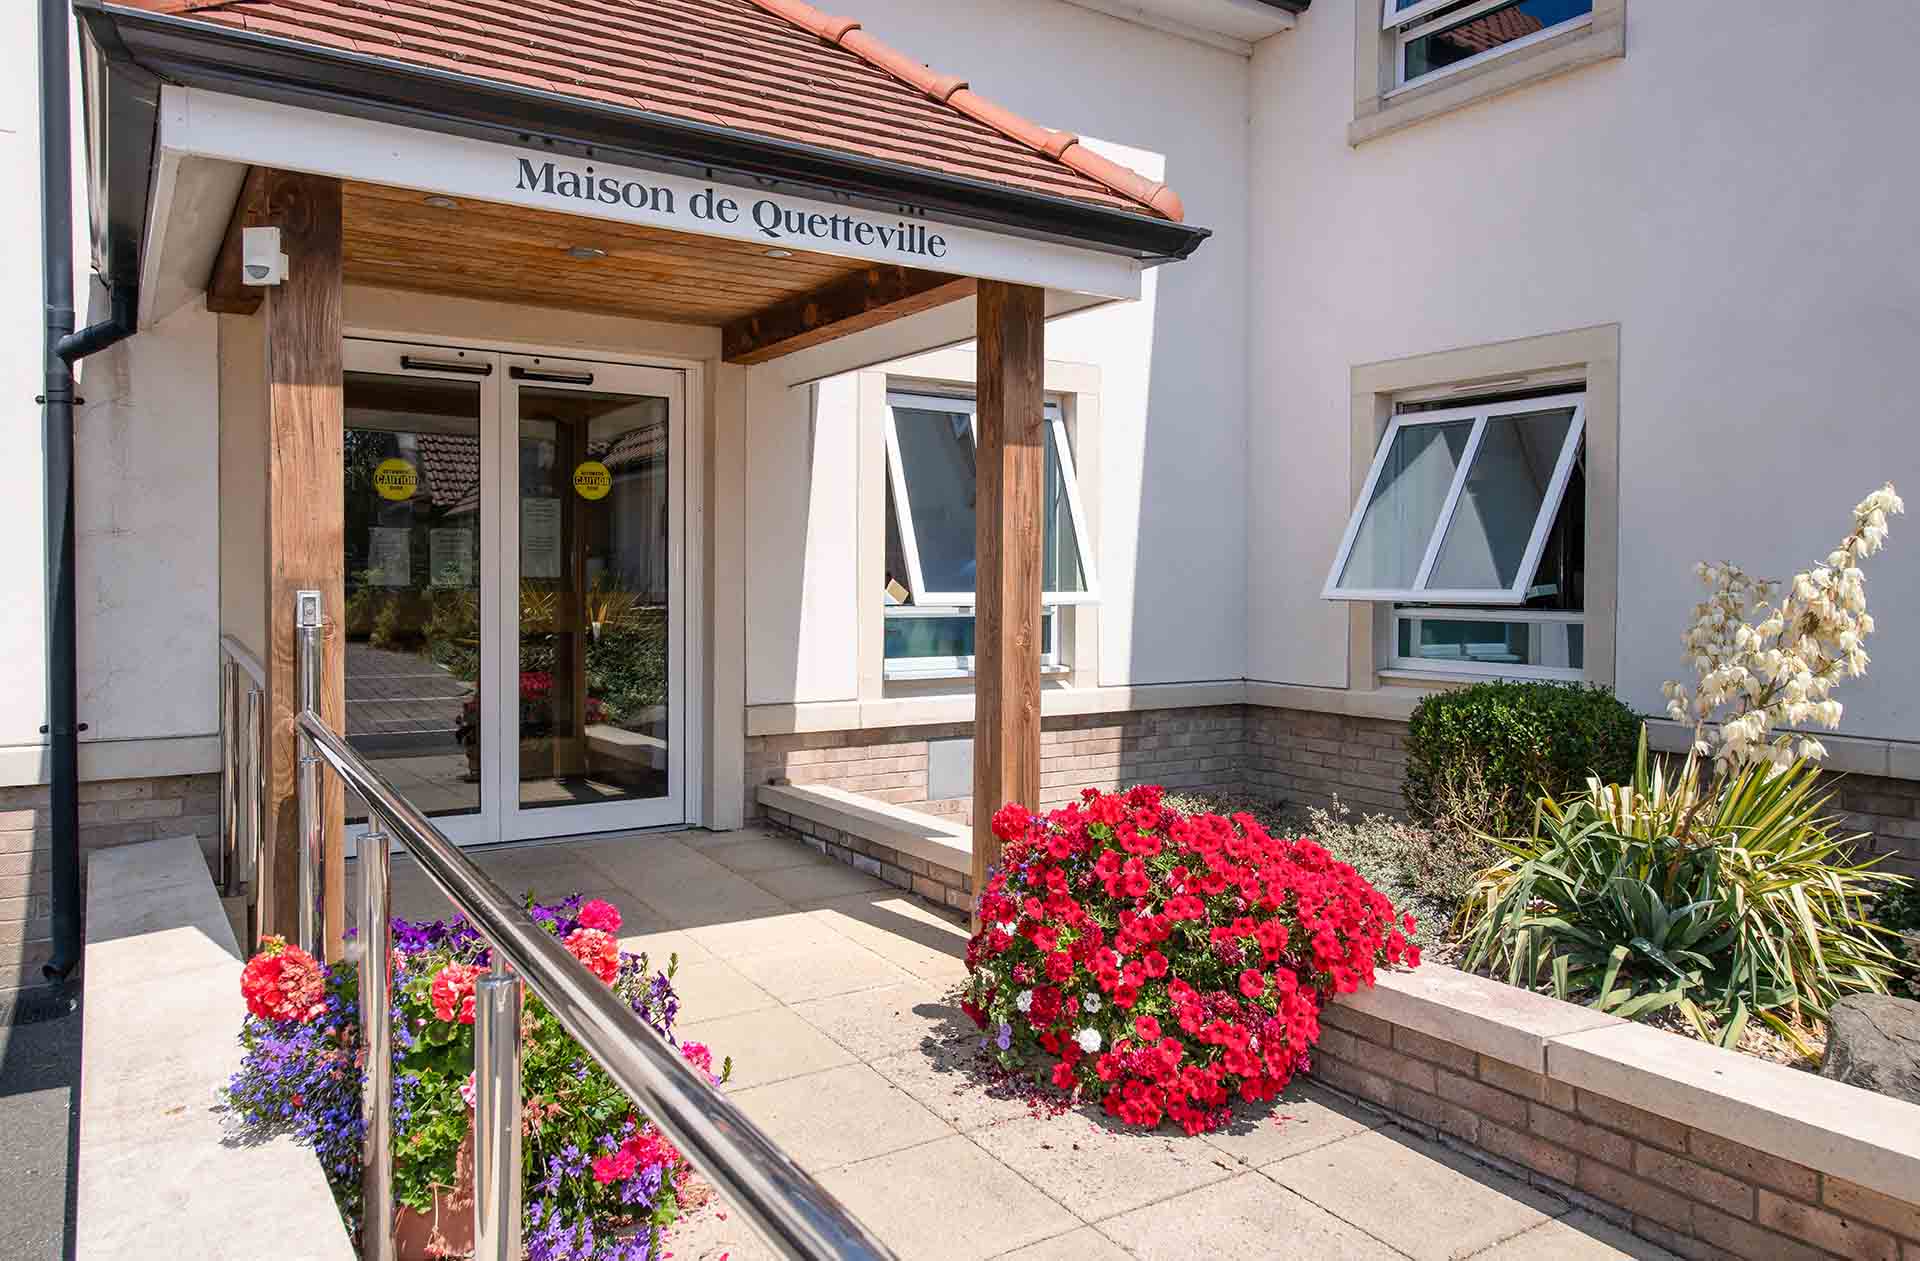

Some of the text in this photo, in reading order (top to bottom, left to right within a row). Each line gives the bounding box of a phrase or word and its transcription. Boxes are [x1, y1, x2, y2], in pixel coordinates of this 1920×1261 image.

[515, 158, 947, 258] Maison de Quetteville
[375, 474, 417, 485] CAUTION
[575, 476, 610, 486] CAUTION
